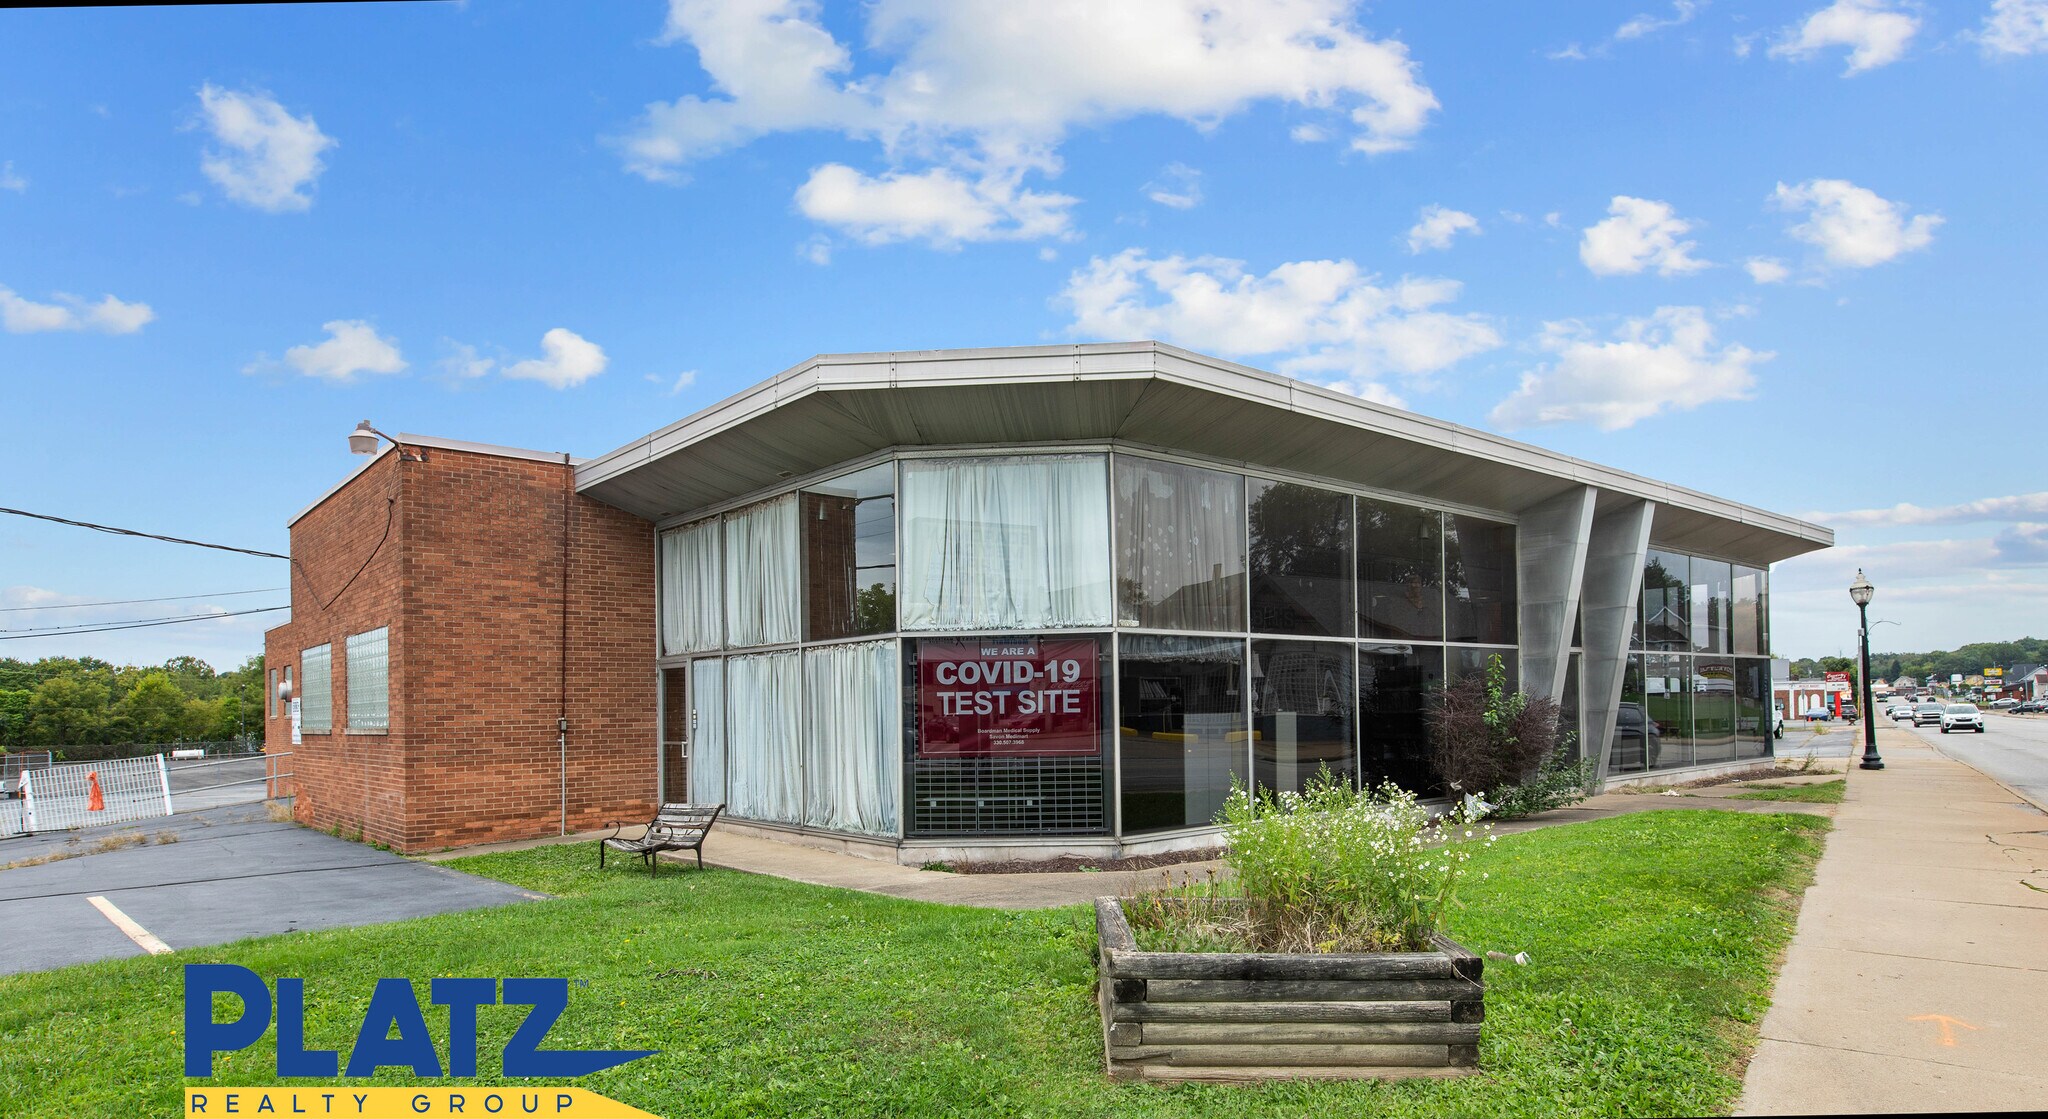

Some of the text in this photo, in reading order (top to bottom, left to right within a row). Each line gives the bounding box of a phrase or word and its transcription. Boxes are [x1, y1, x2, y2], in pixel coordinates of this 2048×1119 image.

[981, 647, 1035, 656] WE ARE A
[936, 659, 1080, 685] COVID-19
[936, 689, 1081, 716] TEST SITE
